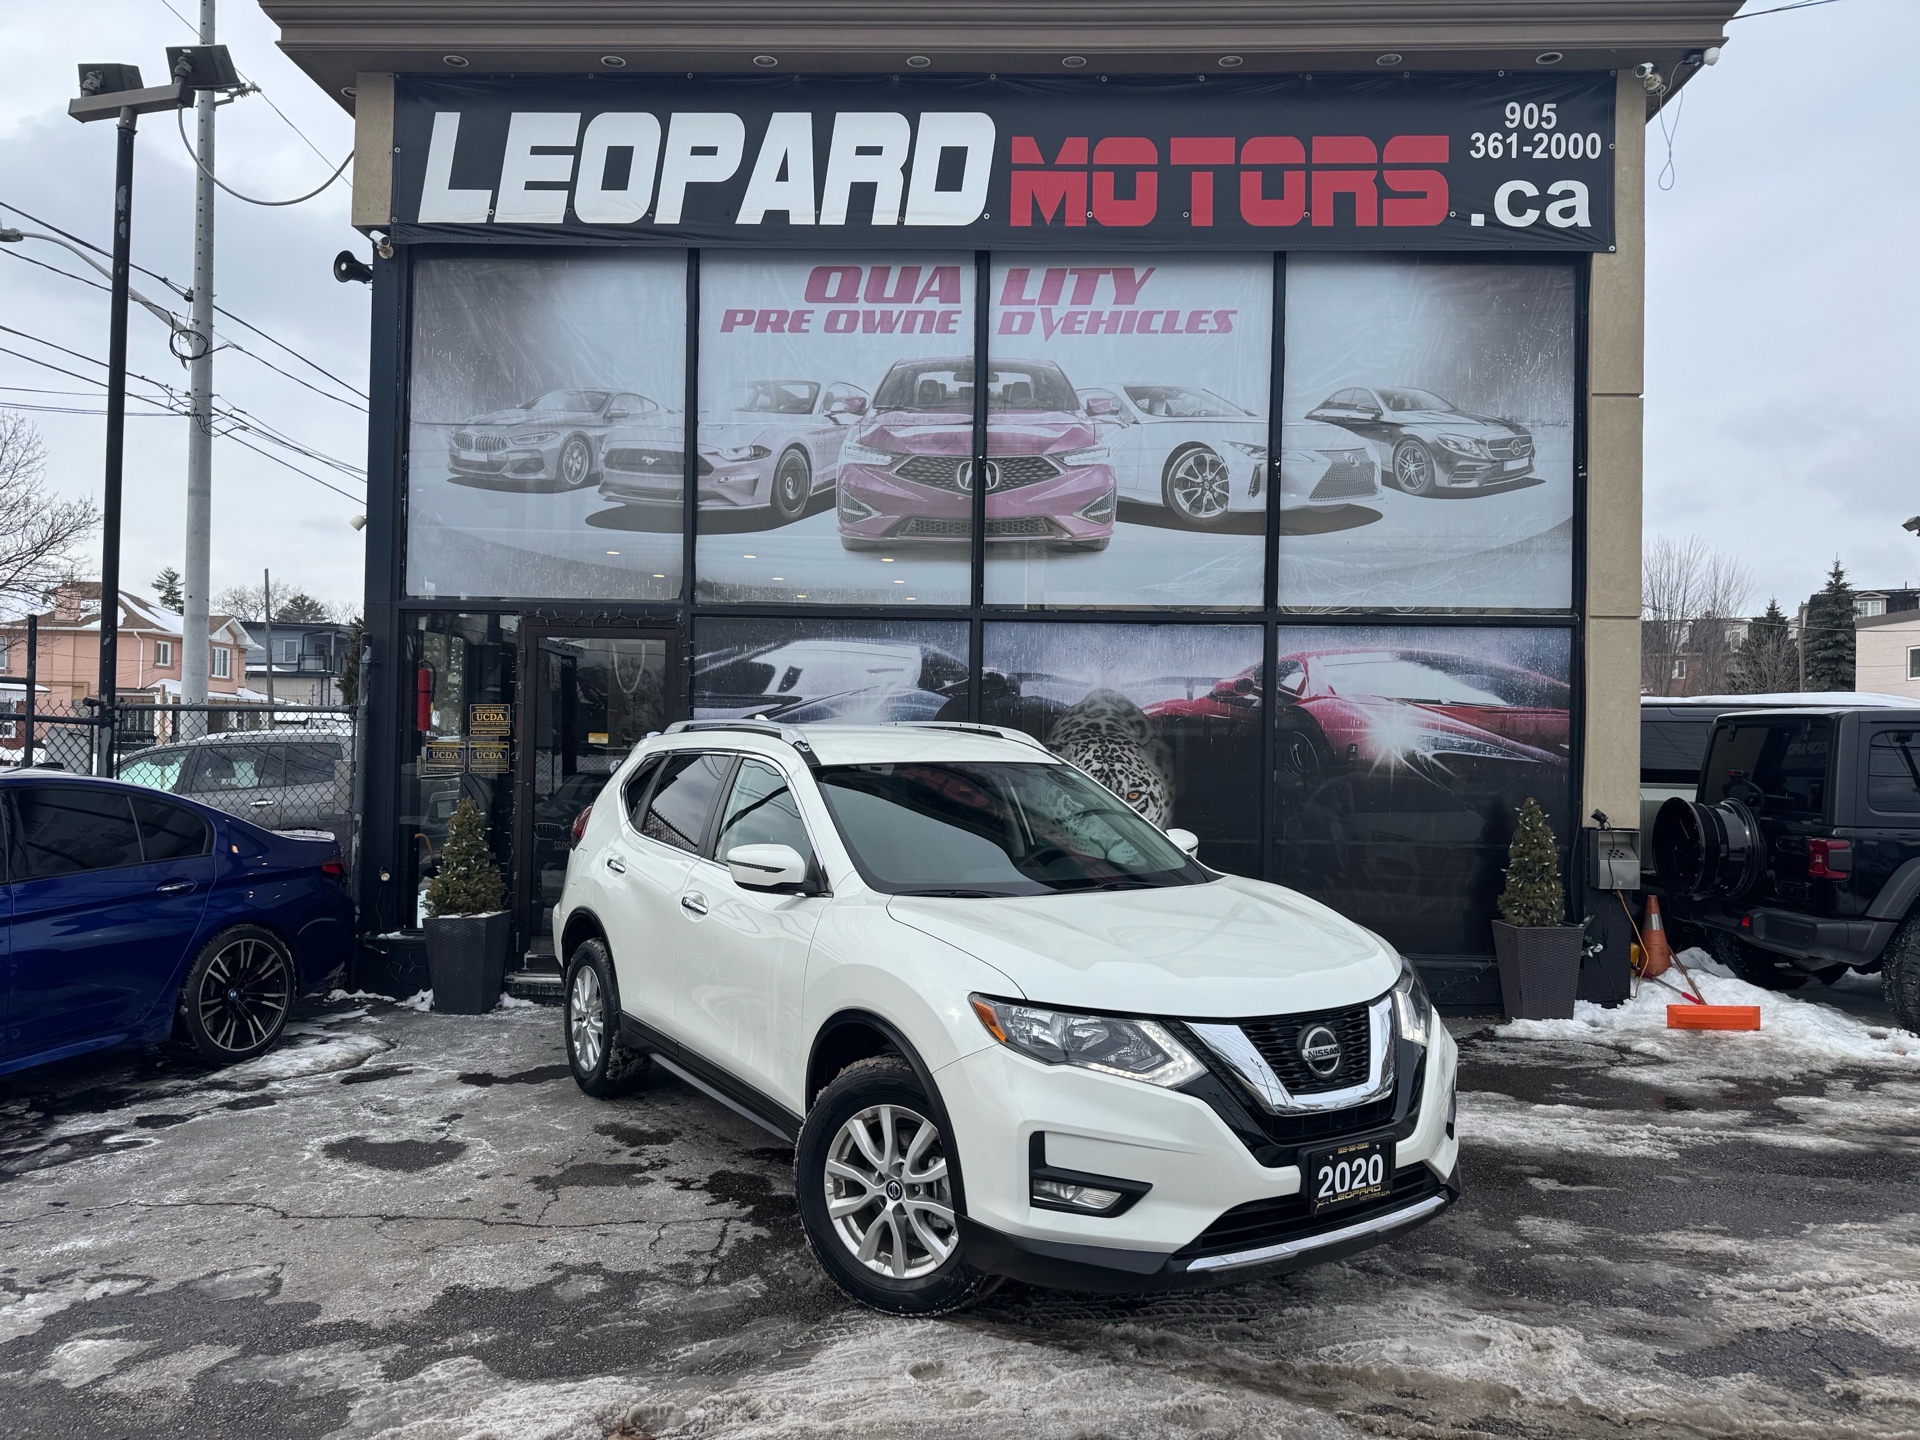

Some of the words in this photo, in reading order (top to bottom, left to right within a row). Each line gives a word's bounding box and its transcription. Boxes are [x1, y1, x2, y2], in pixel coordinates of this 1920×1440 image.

[1504, 101, 1558, 130] 905
[1469, 132, 1602, 160] 361-2000
[417, 111, 996, 226] LEOPARD
[1010, 135, 1450, 227] MOTORS
[1470, 179, 1592, 228] .ca
[719, 309, 815, 334] PRE
[432, 751, 459, 759] UCDA
[476, 751, 503, 759] UCDA
[1307, 1046, 1340, 1059] NISSAN
[1317, 1153, 1384, 1198] 2020
[1330, 1184, 1382, 1203] LEOPARD
